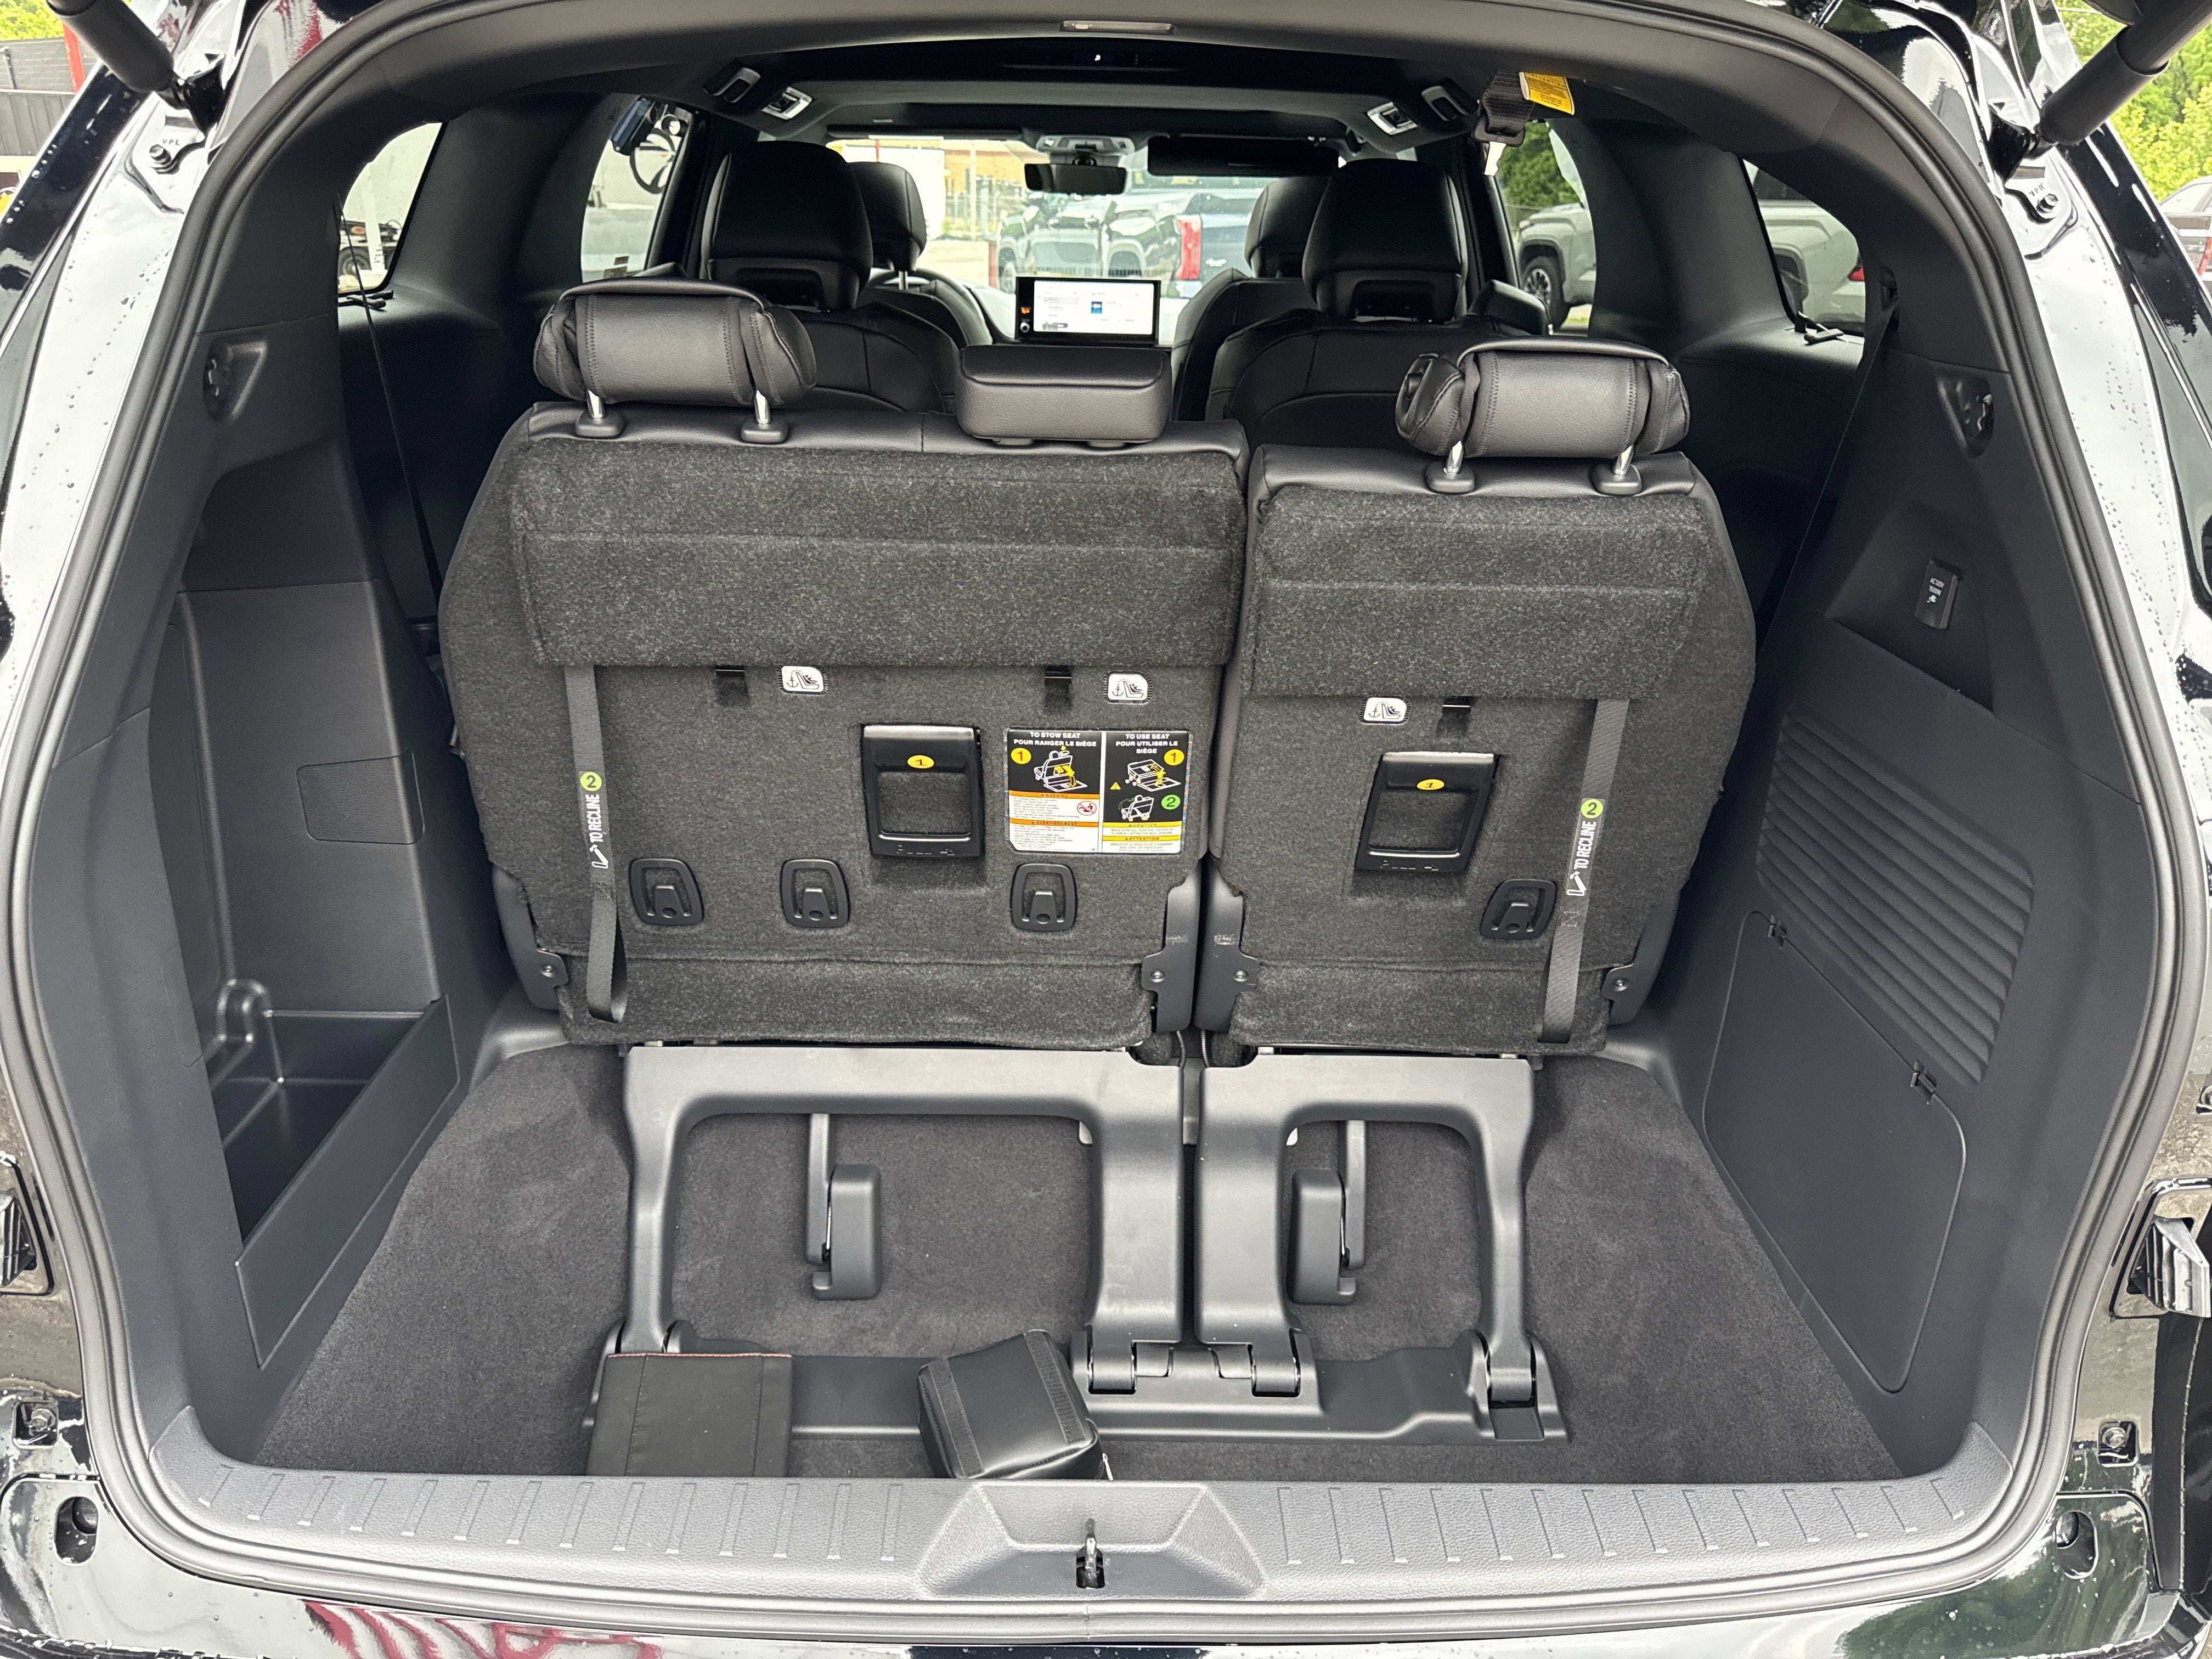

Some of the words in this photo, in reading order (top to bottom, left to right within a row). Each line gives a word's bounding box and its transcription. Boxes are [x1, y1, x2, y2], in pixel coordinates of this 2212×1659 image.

[1017, 751, 1023, 761] 1
[1170, 752, 1176, 763] 1
[586, 775, 596, 788] 2
[1166, 797, 1176, 807] 2
[585, 794, 602, 831] RECLINE
[1586, 802, 1598, 816] 2
[589, 832, 603, 843] TO
[1576, 820, 1596, 857] RECLINE
[1573, 858, 1589, 870] TO
